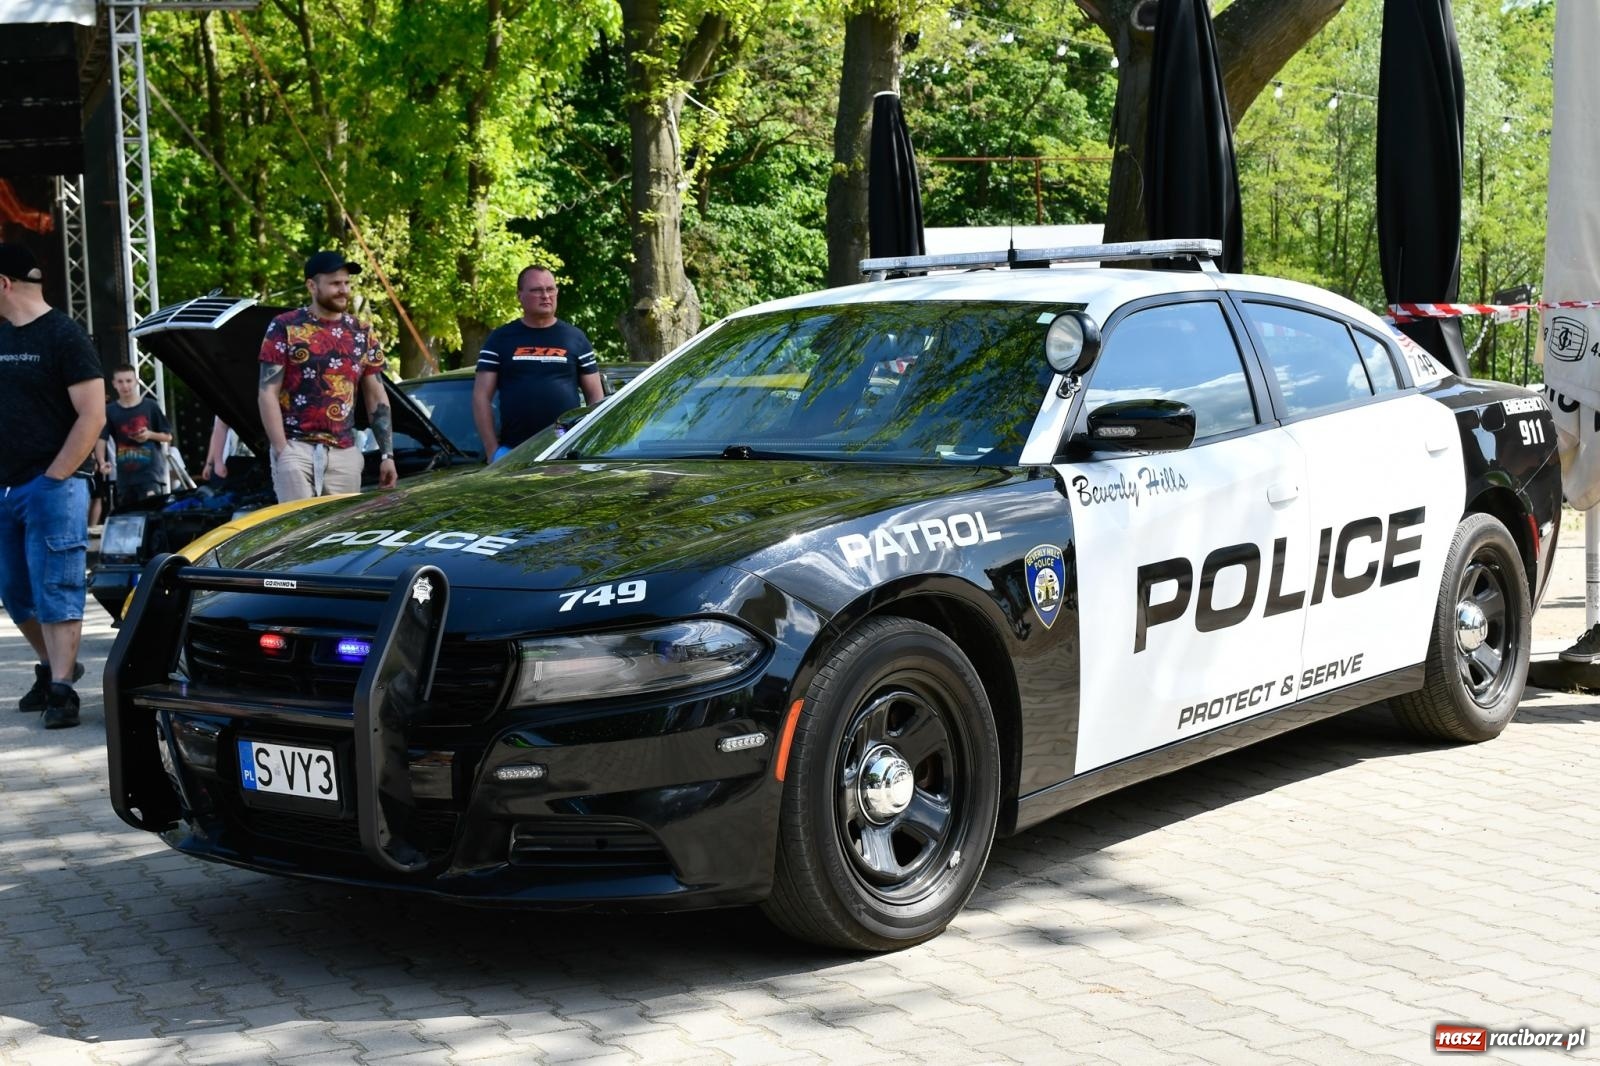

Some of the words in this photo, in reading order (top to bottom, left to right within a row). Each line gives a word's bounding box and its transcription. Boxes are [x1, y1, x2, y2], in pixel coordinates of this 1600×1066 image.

[1519, 418, 1545, 446] 911
[1072, 474, 1140, 507] Beverly
[1138, 467, 1188, 496] Hills
[308, 530, 519, 556] POLICE
[837, 511, 1002, 567] PATROL
[1026, 549, 1046, 566] BEVERLY
[1047, 548, 1060, 559] HILLS
[1034, 558, 1055, 570] POLICE
[558, 580, 647, 612] 749
[1133, 506, 1426, 654] POLICE
[1178, 680, 1275, 730] PROTECT
[1280, 675, 1294, 697] &
[1300, 653, 1364, 690] SERVE
[243, 769, 255, 782] PL
[255, 747, 273, 787] S
[280, 749, 333, 795] VY3
